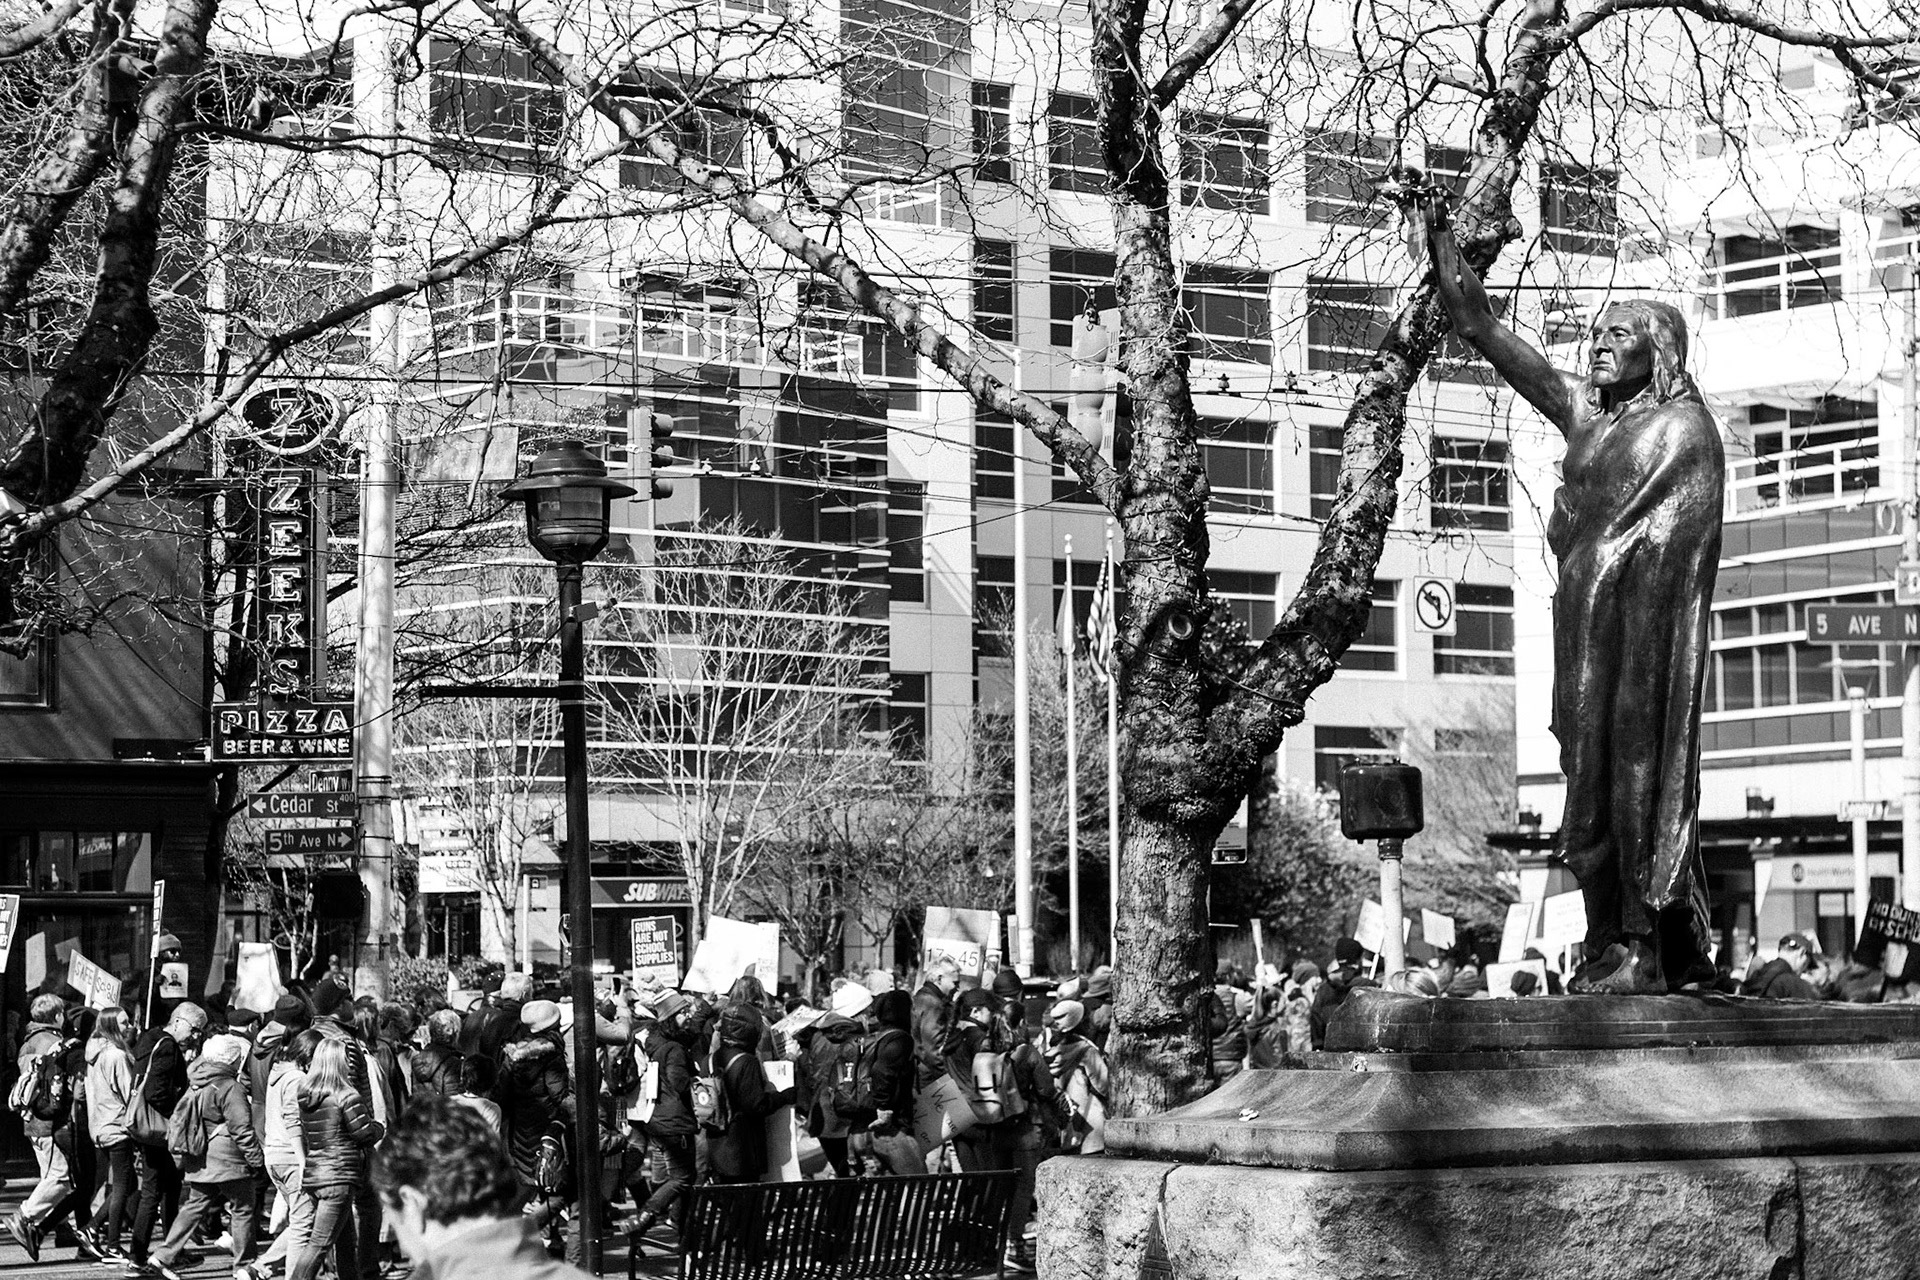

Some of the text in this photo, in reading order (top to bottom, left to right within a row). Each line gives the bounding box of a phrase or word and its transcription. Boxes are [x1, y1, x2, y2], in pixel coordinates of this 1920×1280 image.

[266, 476, 305, 694] ZEEKS
[1816, 613, 1918, 635] 5 AVE N
[220, 709, 350, 734] PIZZA
[223, 738, 350, 754] BEER & WINE
[312, 773, 339, 792] Denny
[270, 794, 354, 814] Cedar St 400
[269, 832, 336, 851] 5th Ave N
[623, 883, 690, 902] SUBWAY
[634, 920, 657, 933] GUNS
[635, 930, 668, 944] ARE NOT
[635, 941, 667, 955] SCHOOL
[636, 951, 674, 966] SUPPLIES
[74, 961, 94, 985] SAFE
